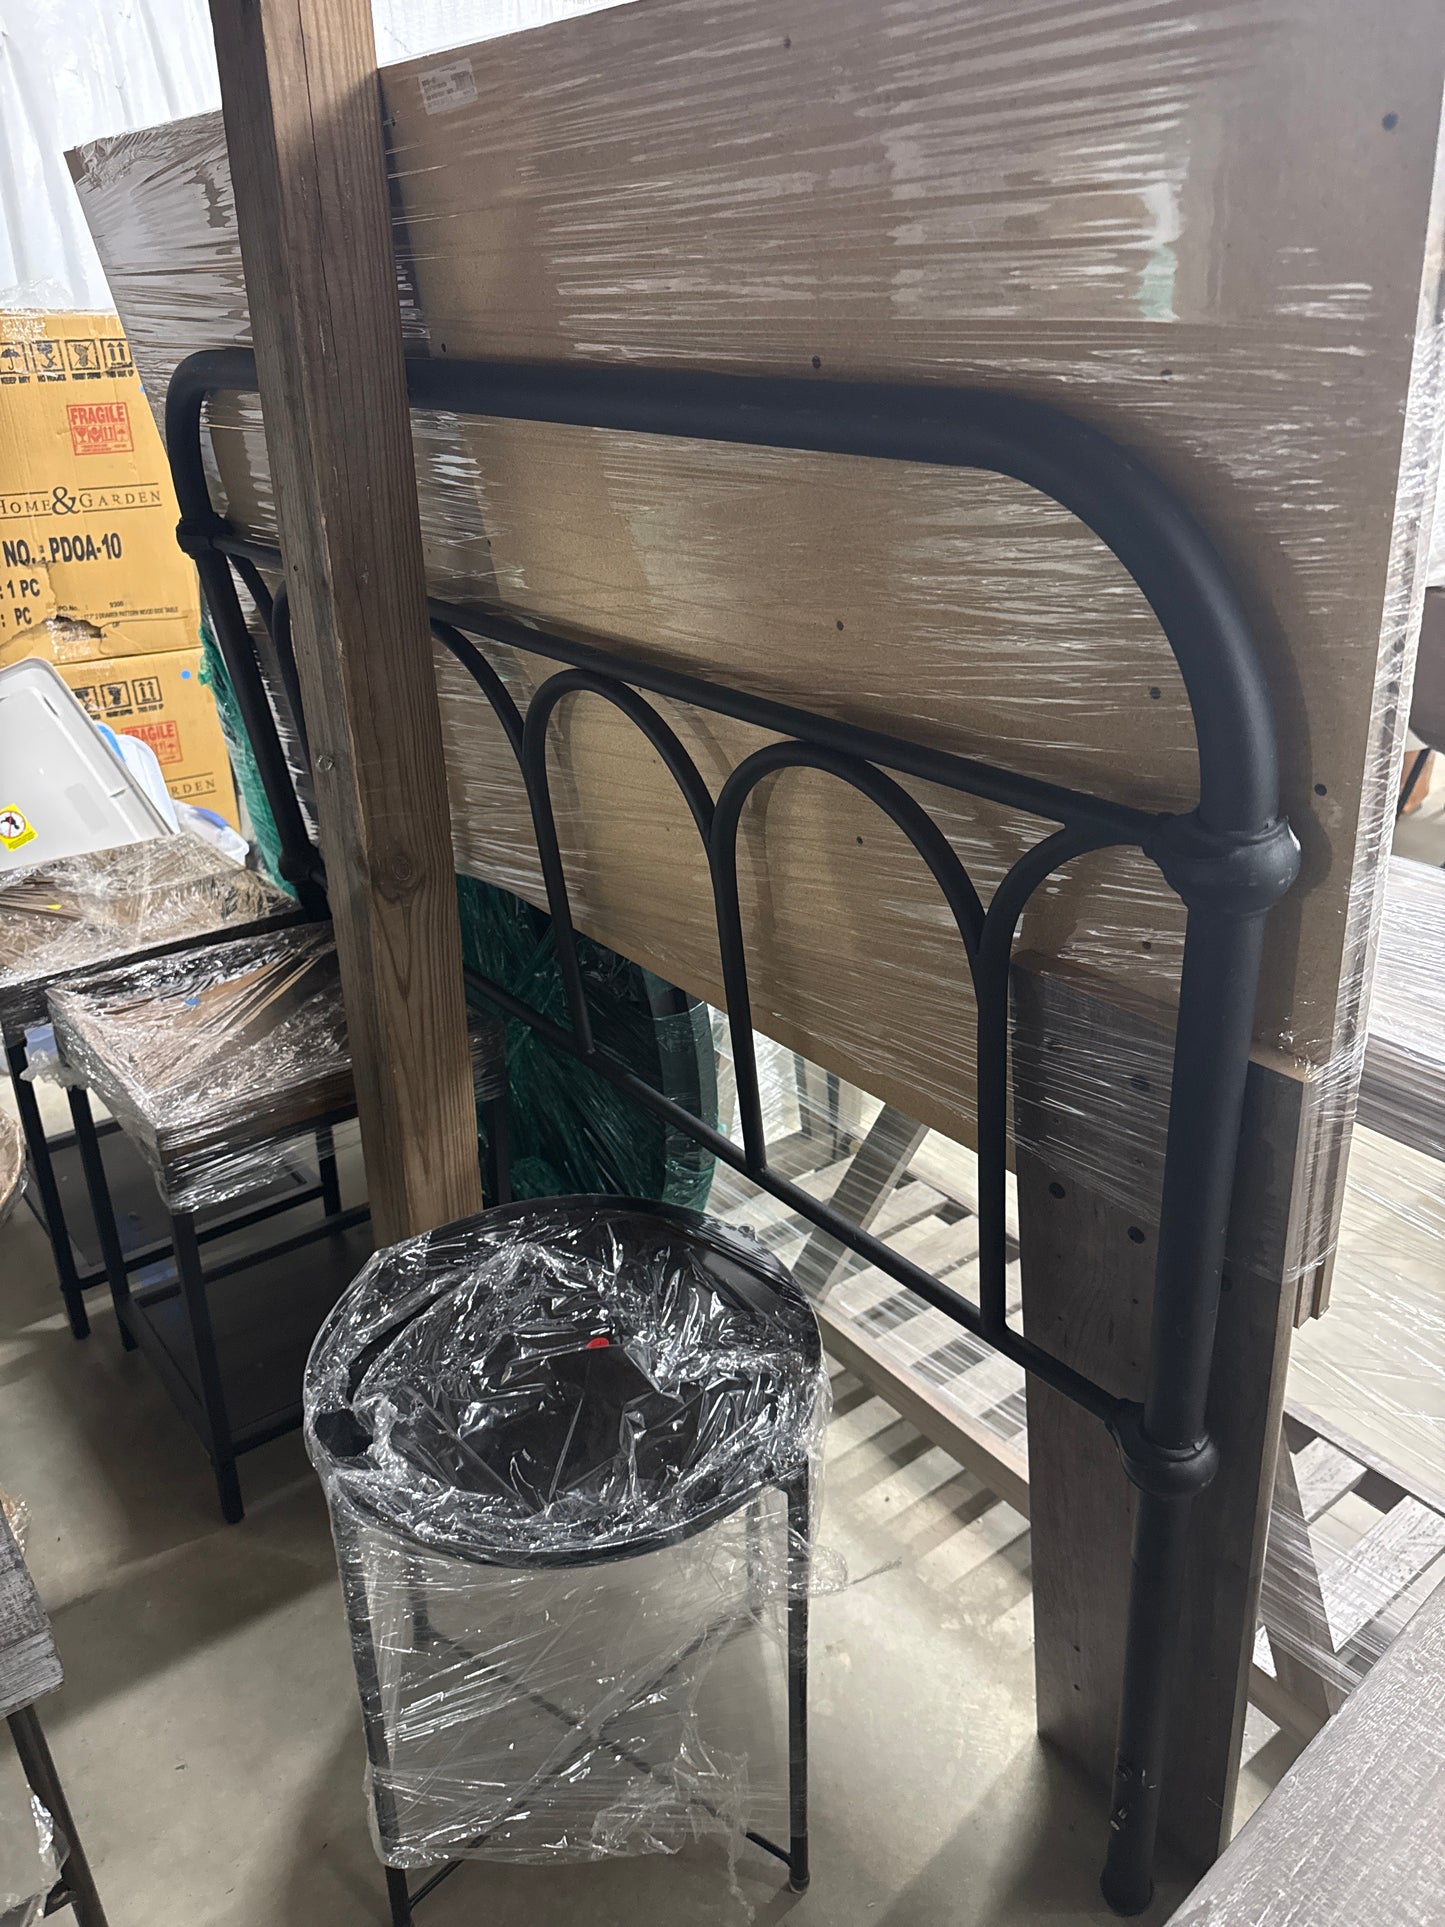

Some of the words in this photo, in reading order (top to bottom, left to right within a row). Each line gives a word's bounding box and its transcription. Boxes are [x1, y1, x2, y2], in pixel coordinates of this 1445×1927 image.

[70, 405, 126, 425] FRAGILE
[48, 532, 122, 564] PDOA-10
[19, 578, 41, 598] PC
[14, 606, 32, 626] PC
